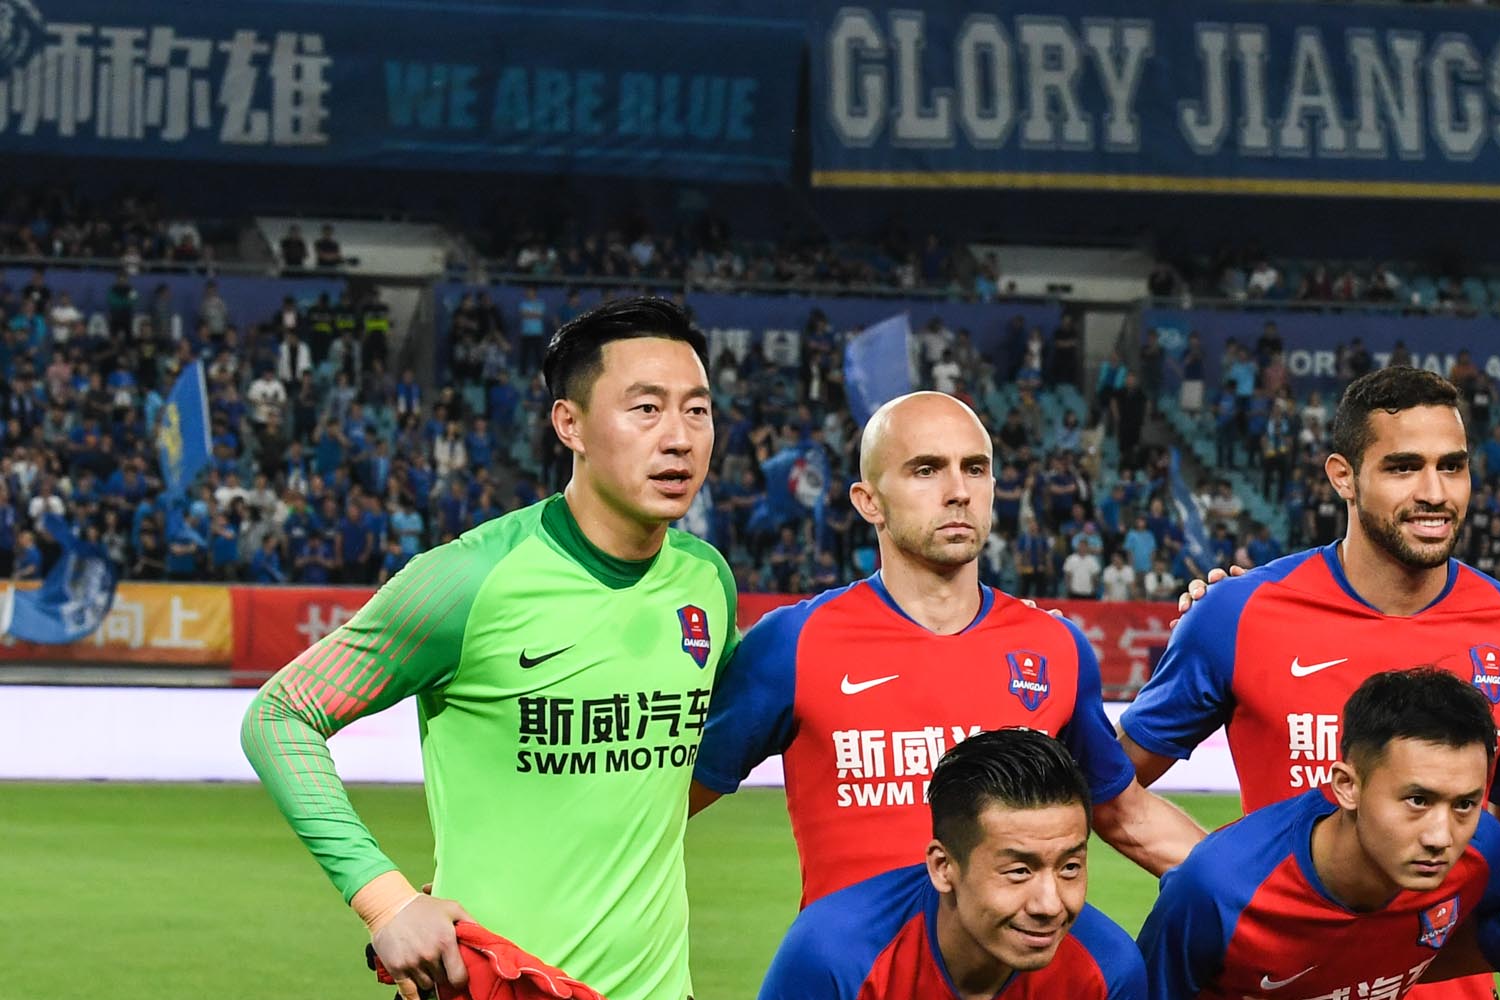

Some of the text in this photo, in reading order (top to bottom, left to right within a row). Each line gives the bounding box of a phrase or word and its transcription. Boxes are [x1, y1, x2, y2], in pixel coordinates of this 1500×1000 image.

[383, 59, 761, 141] WE ARE BLUE
[828, 8, 1152, 150] GLORY
[518, 688, 711, 746] 斯威汽车
[516, 744, 698, 775] SWM MOTOR
[1289, 765, 1334, 788] SW
[836, 781, 915, 808] SWM
